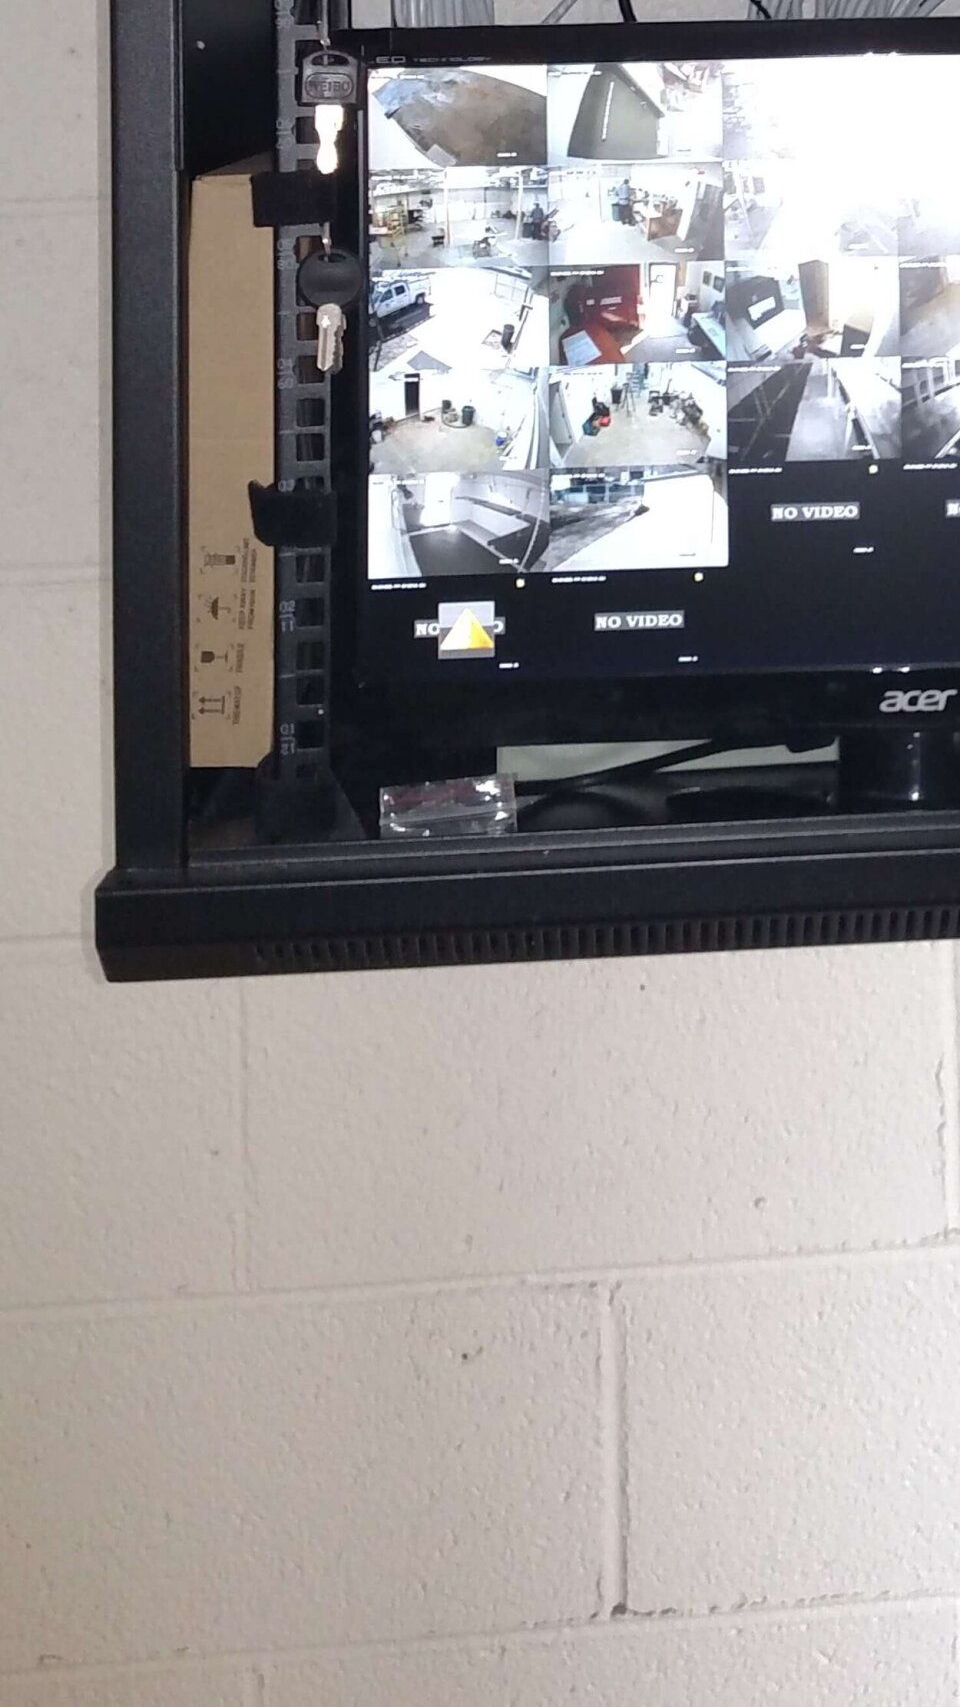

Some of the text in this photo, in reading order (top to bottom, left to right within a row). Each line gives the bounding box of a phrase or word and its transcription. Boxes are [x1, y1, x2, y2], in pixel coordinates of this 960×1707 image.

[772, 505, 858, 520] NO VIDEO
[416, 621, 440, 636] NO
[595, 613, 683, 629] NO VIDEO
[879, 689, 958, 713] acer
